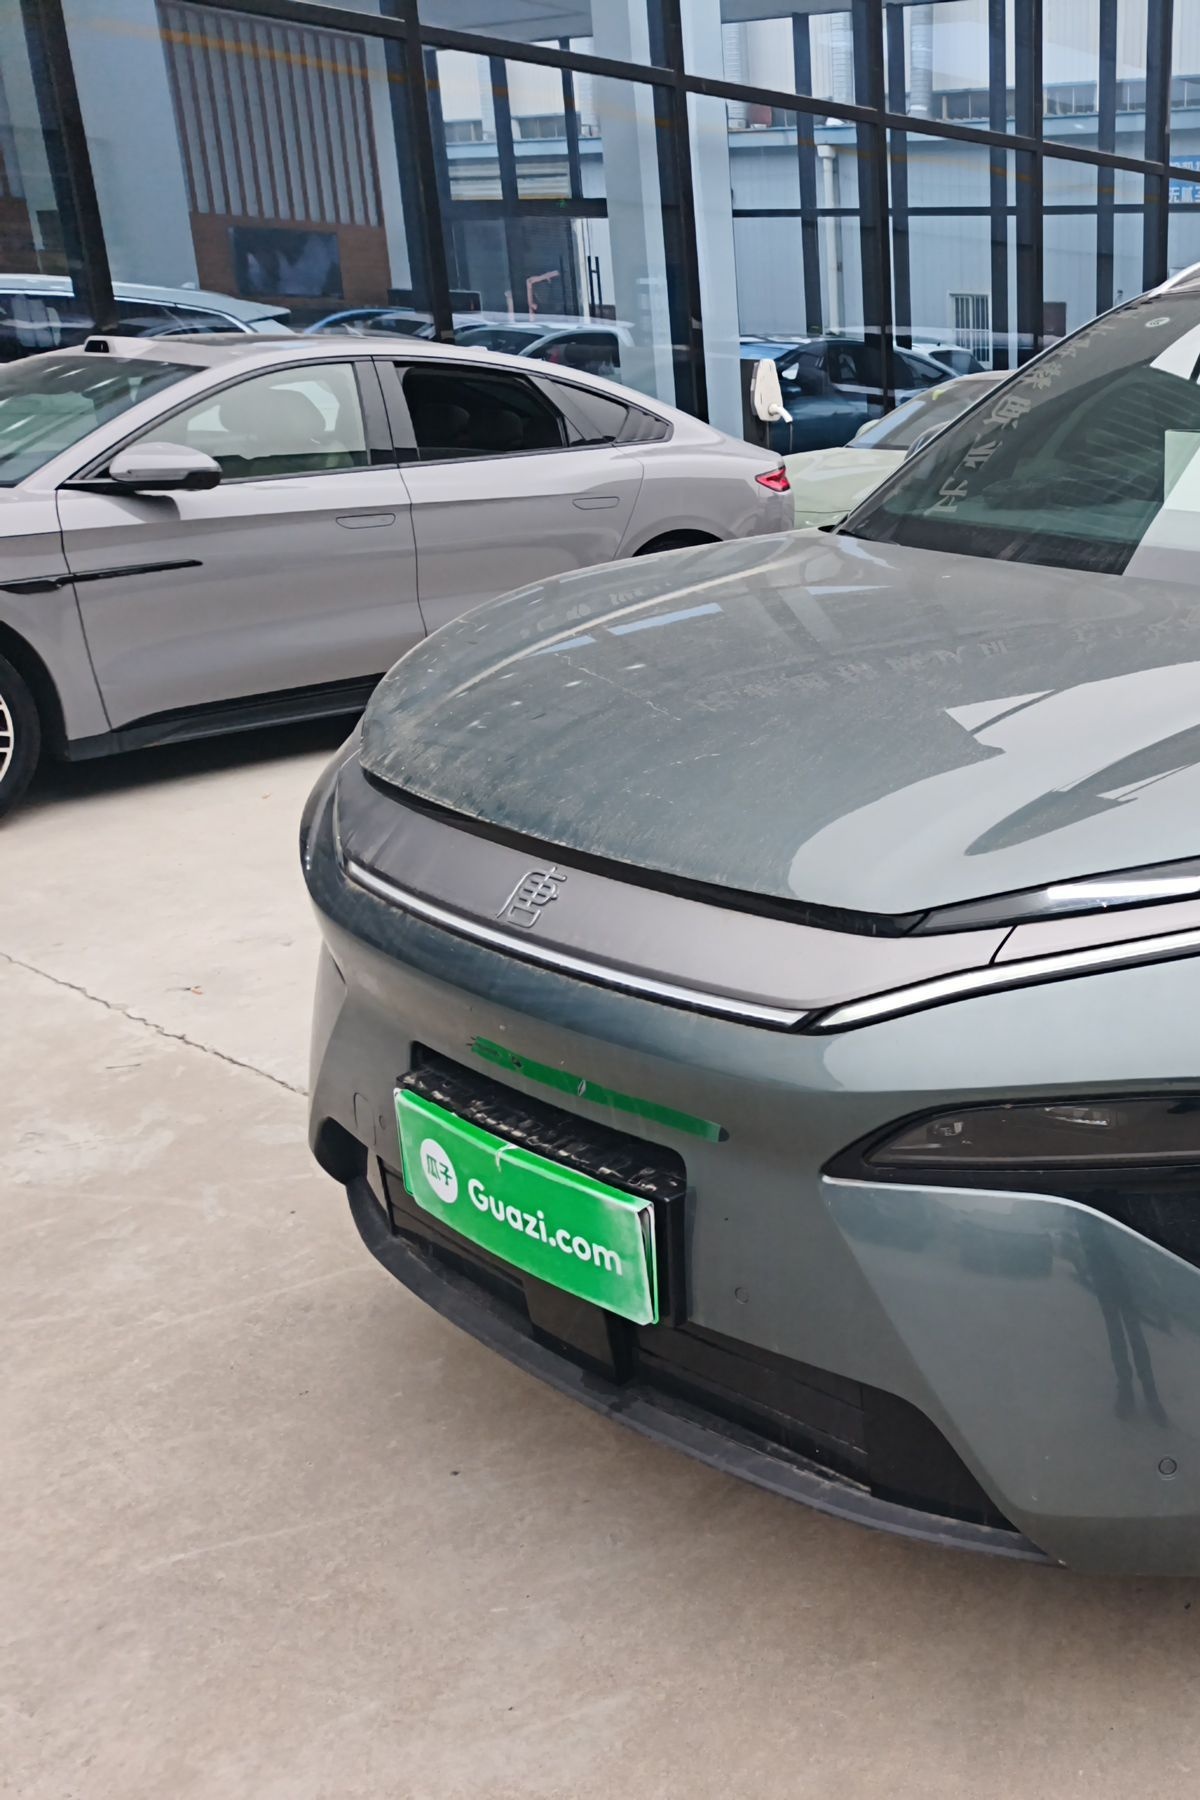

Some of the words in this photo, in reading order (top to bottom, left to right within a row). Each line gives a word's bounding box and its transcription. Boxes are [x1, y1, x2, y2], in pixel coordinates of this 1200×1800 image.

[496, 866, 567, 928] 唐
[426, 1153, 453, 1186] 瓜子
[467, 1177, 624, 1277] Guazi.com
